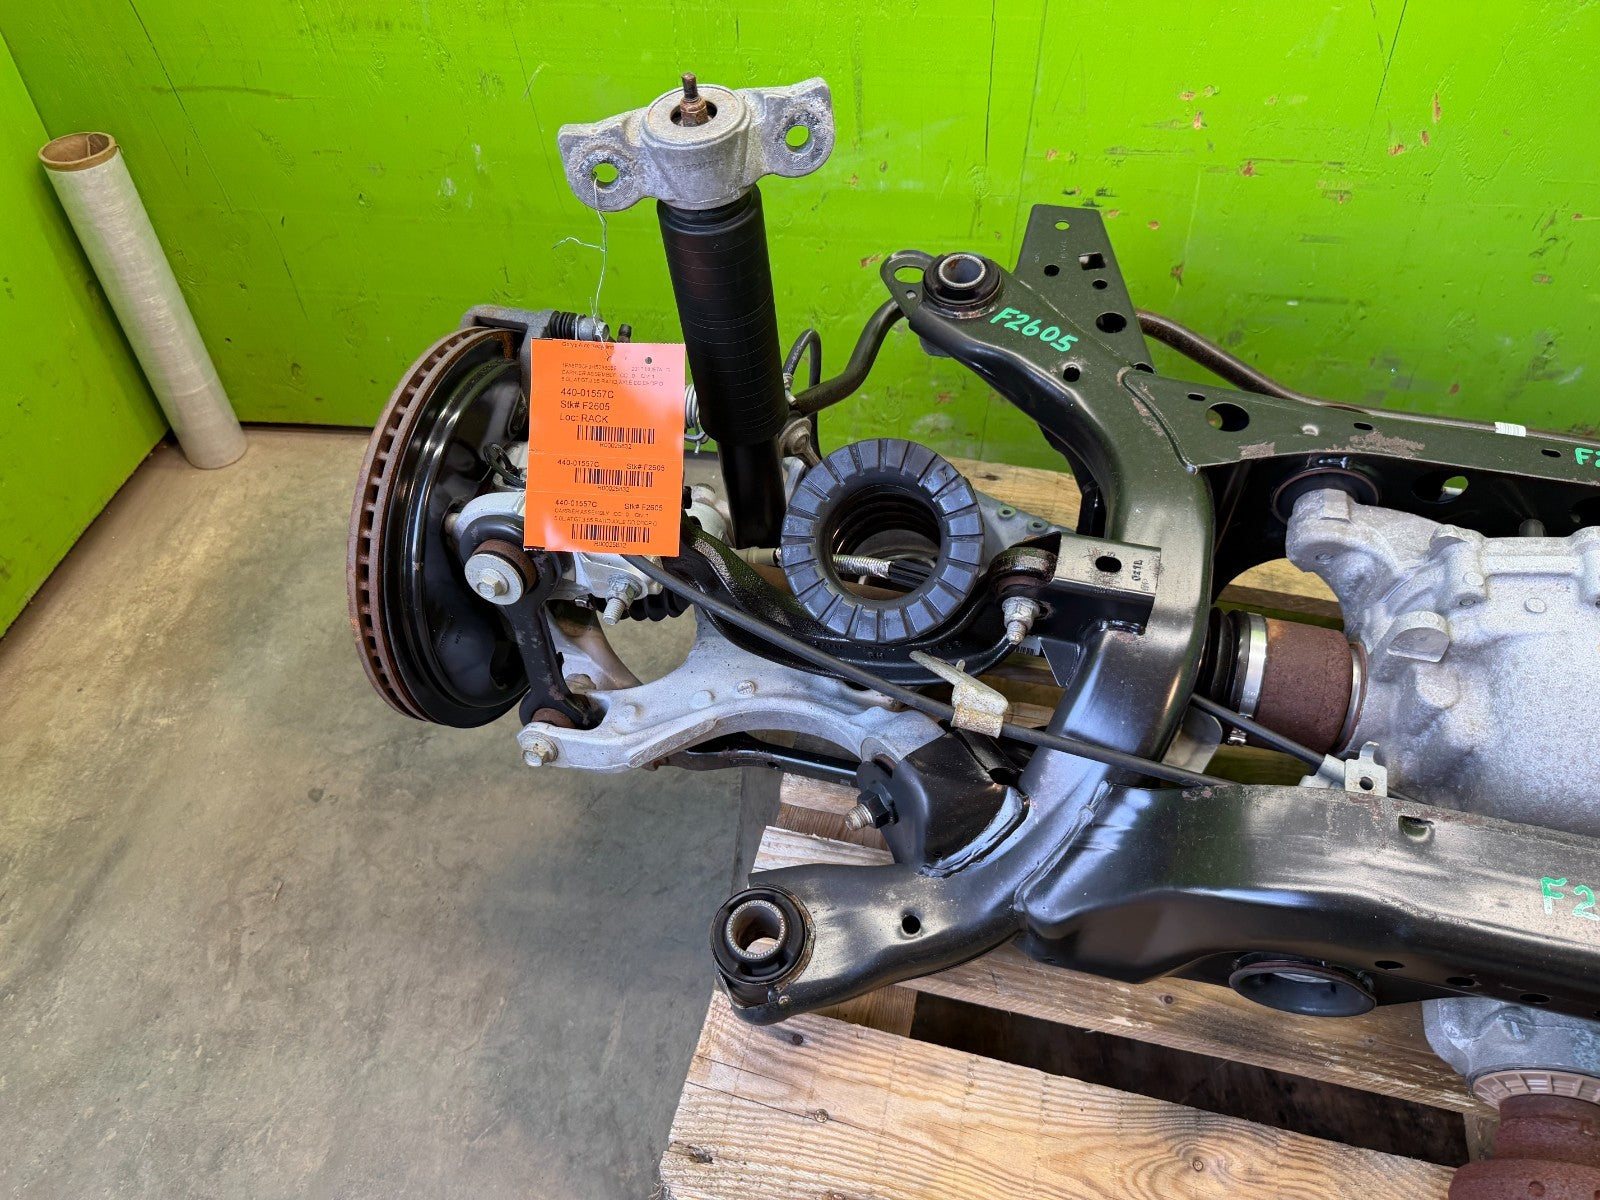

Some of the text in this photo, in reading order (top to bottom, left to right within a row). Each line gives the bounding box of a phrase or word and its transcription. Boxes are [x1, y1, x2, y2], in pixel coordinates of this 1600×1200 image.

[990, 307, 1079, 352] F2605
[560, 388, 614, 399] 440-01557C
[560, 400, 610, 411] Stk# F2605
[559, 413, 609, 423] Loc: RACK
[557, 459, 666, 472] 440-01557C Stk# F2605
[555, 499, 663, 512] 440-01557C Stk# F2605
